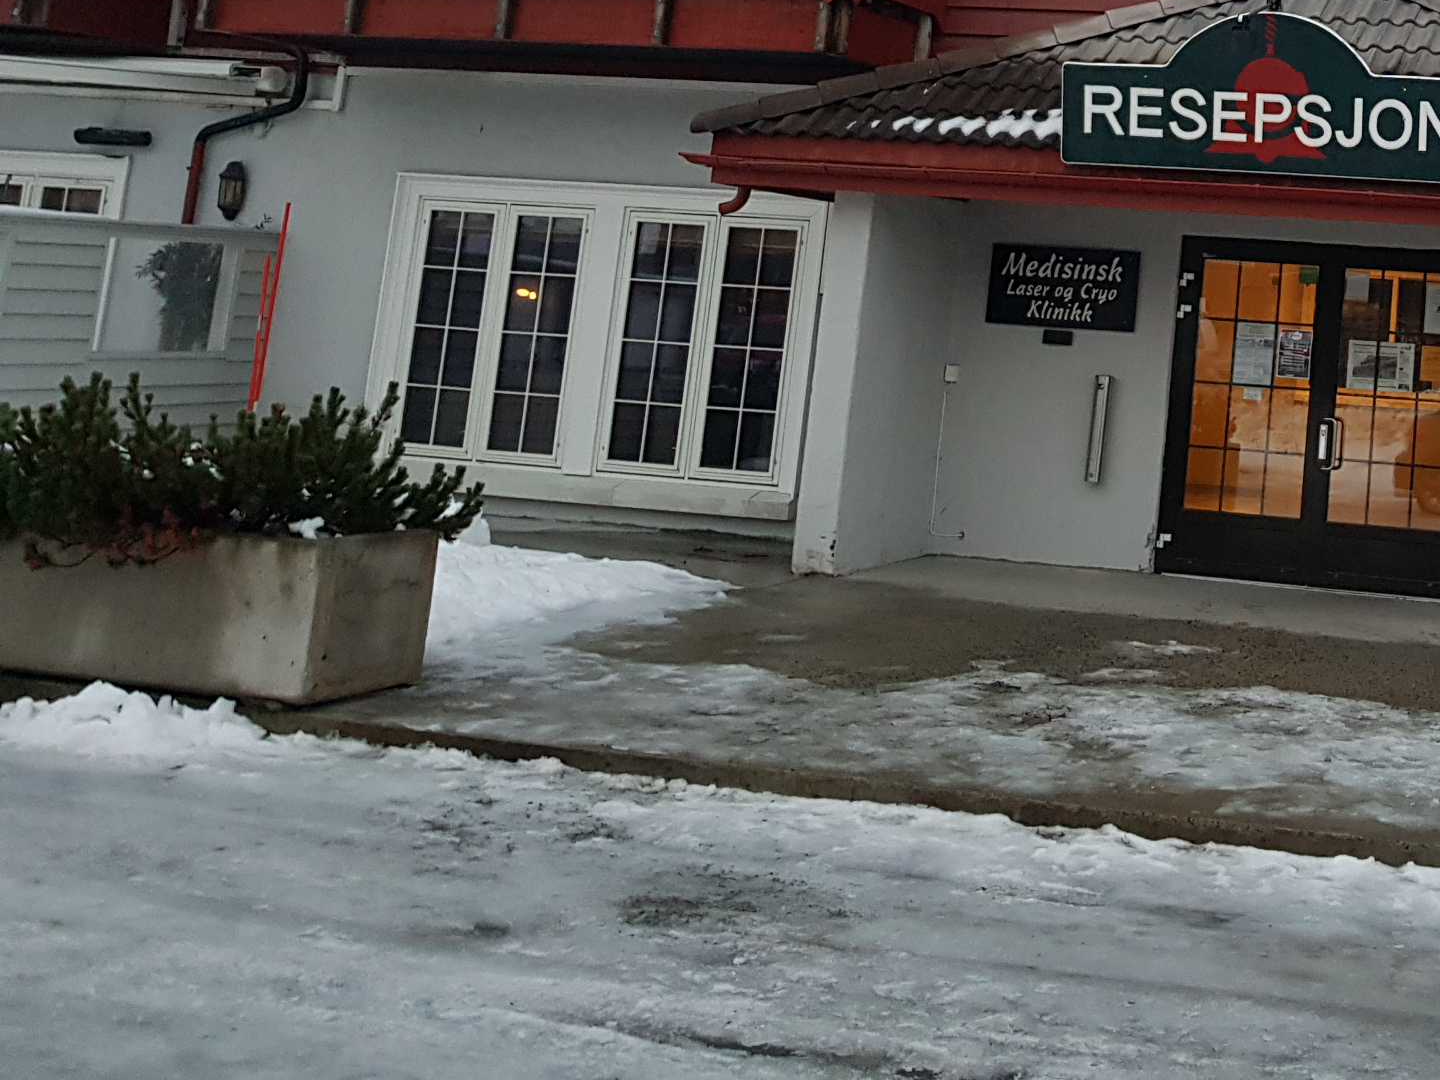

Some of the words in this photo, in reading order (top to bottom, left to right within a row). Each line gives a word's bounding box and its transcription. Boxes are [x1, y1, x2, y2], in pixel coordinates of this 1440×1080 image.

[1001, 252, 1123, 283] Medisinsk
[1006, 279, 1050, 297] Laser
[1054, 286, 1074, 302] og
[1080, 283, 1118, 304] Cryo
[1027, 299, 1093, 323] Klinikk
